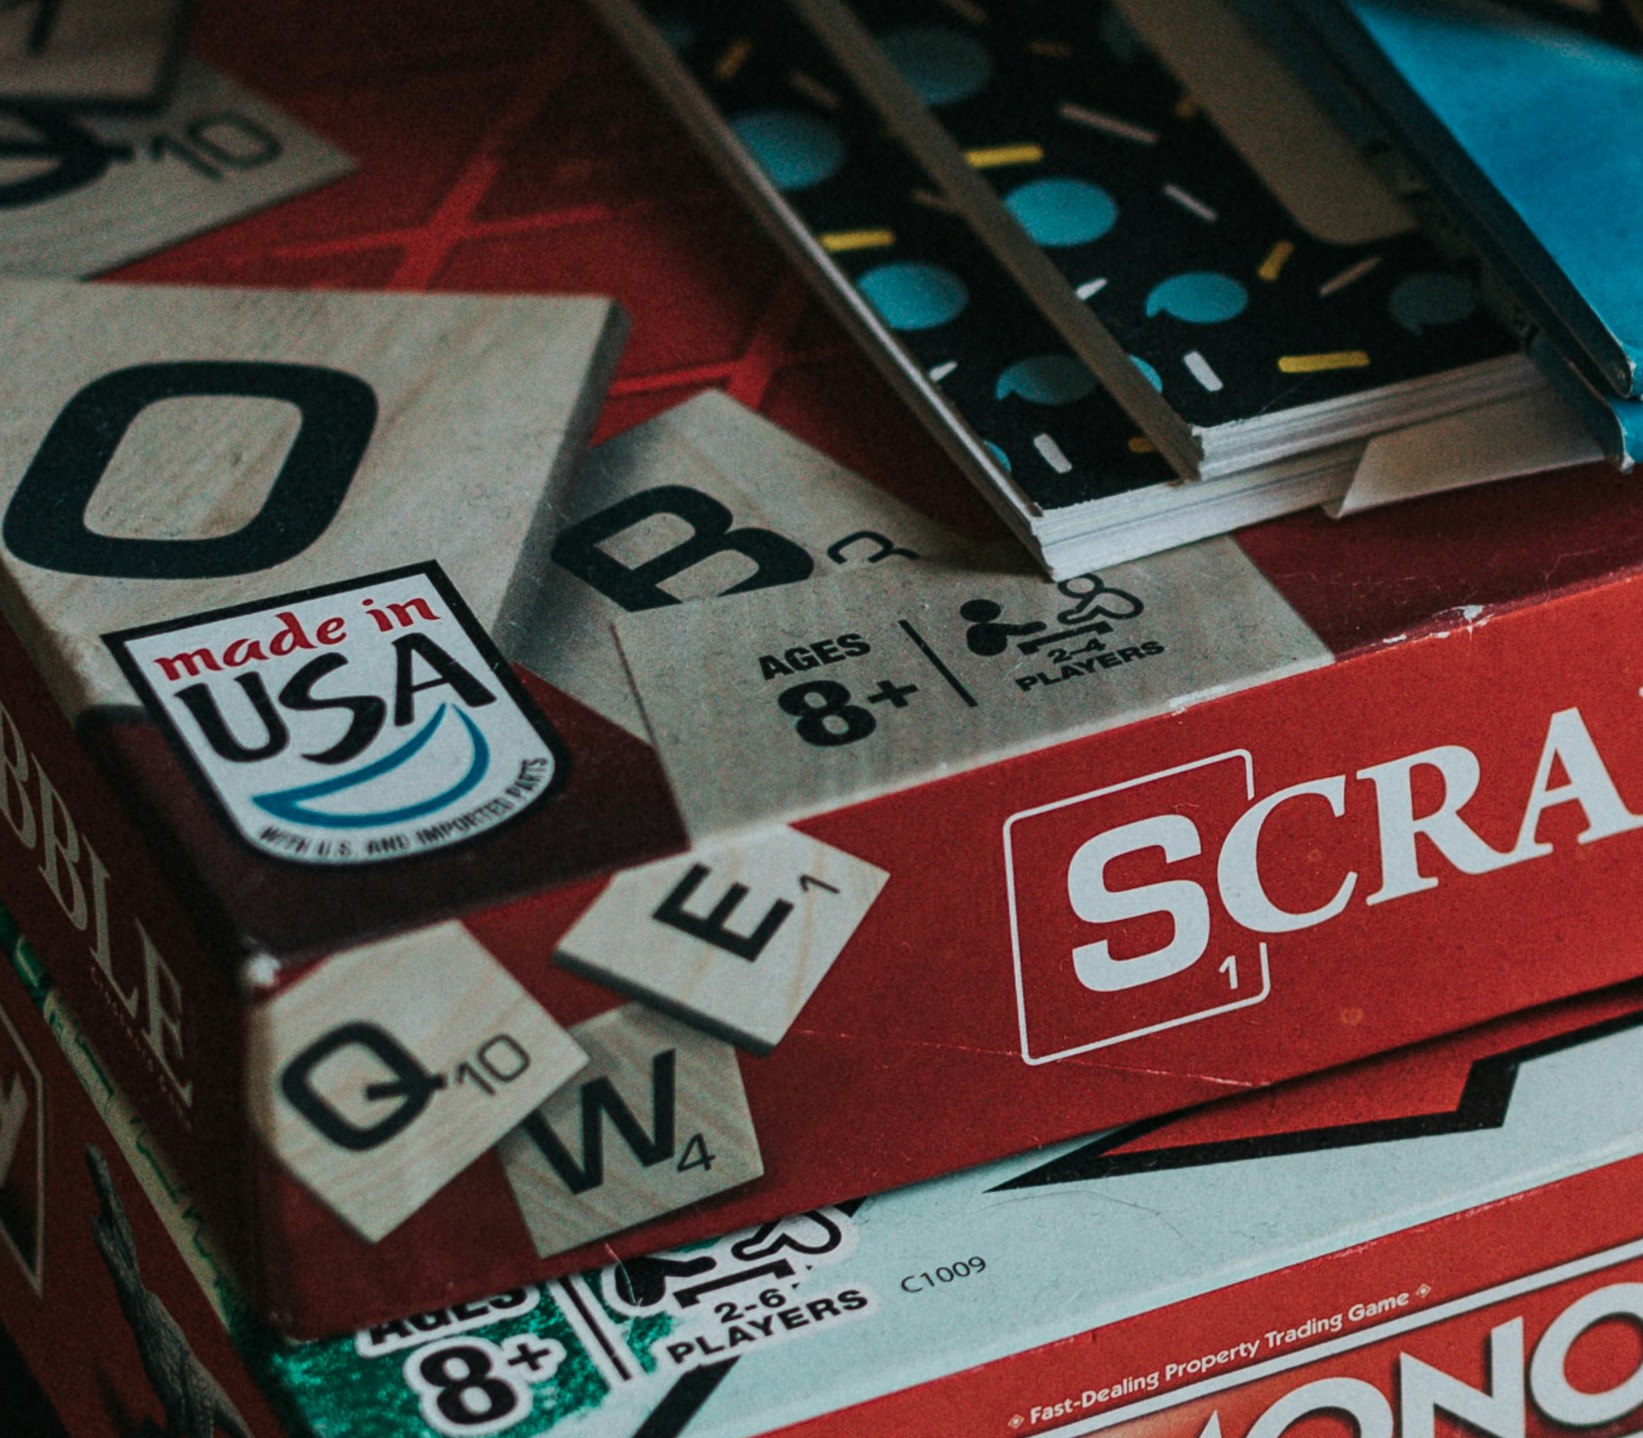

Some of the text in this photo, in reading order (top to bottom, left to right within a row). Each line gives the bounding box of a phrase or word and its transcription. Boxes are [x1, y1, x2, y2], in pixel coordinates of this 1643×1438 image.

[143, 110, 284, 181] 10
[4, 361, 378, 579] O
[550, 484, 815, 613] B
[155, 597, 441, 681] made in
[759, 633, 872, 680] AGES
[1015, 639, 1164, 692] PLAYERS
[1047, 638, 1105, 663] 2-4
[174, 631, 497, 766] USA
[777, 677, 919, 747] 8+
[259, 756, 549, 858] WITH U.S. AND IMPORTED PARTS
[652, 862, 841, 962] E 1
[1217, 953, 1241, 992] 1
[282, 1019, 531, 1152] Q 10
[524, 1047, 716, 1195] W 4
[713, 1287, 783, 1324] 2-6
[900, 1255, 987, 1294] C1009
[667, 1289, 869, 1367] PLAYERS
[1030, 1290, 1409, 1424] Fast-Dealing Property Trading Game
[418, 1340, 552, 1427] 8+
